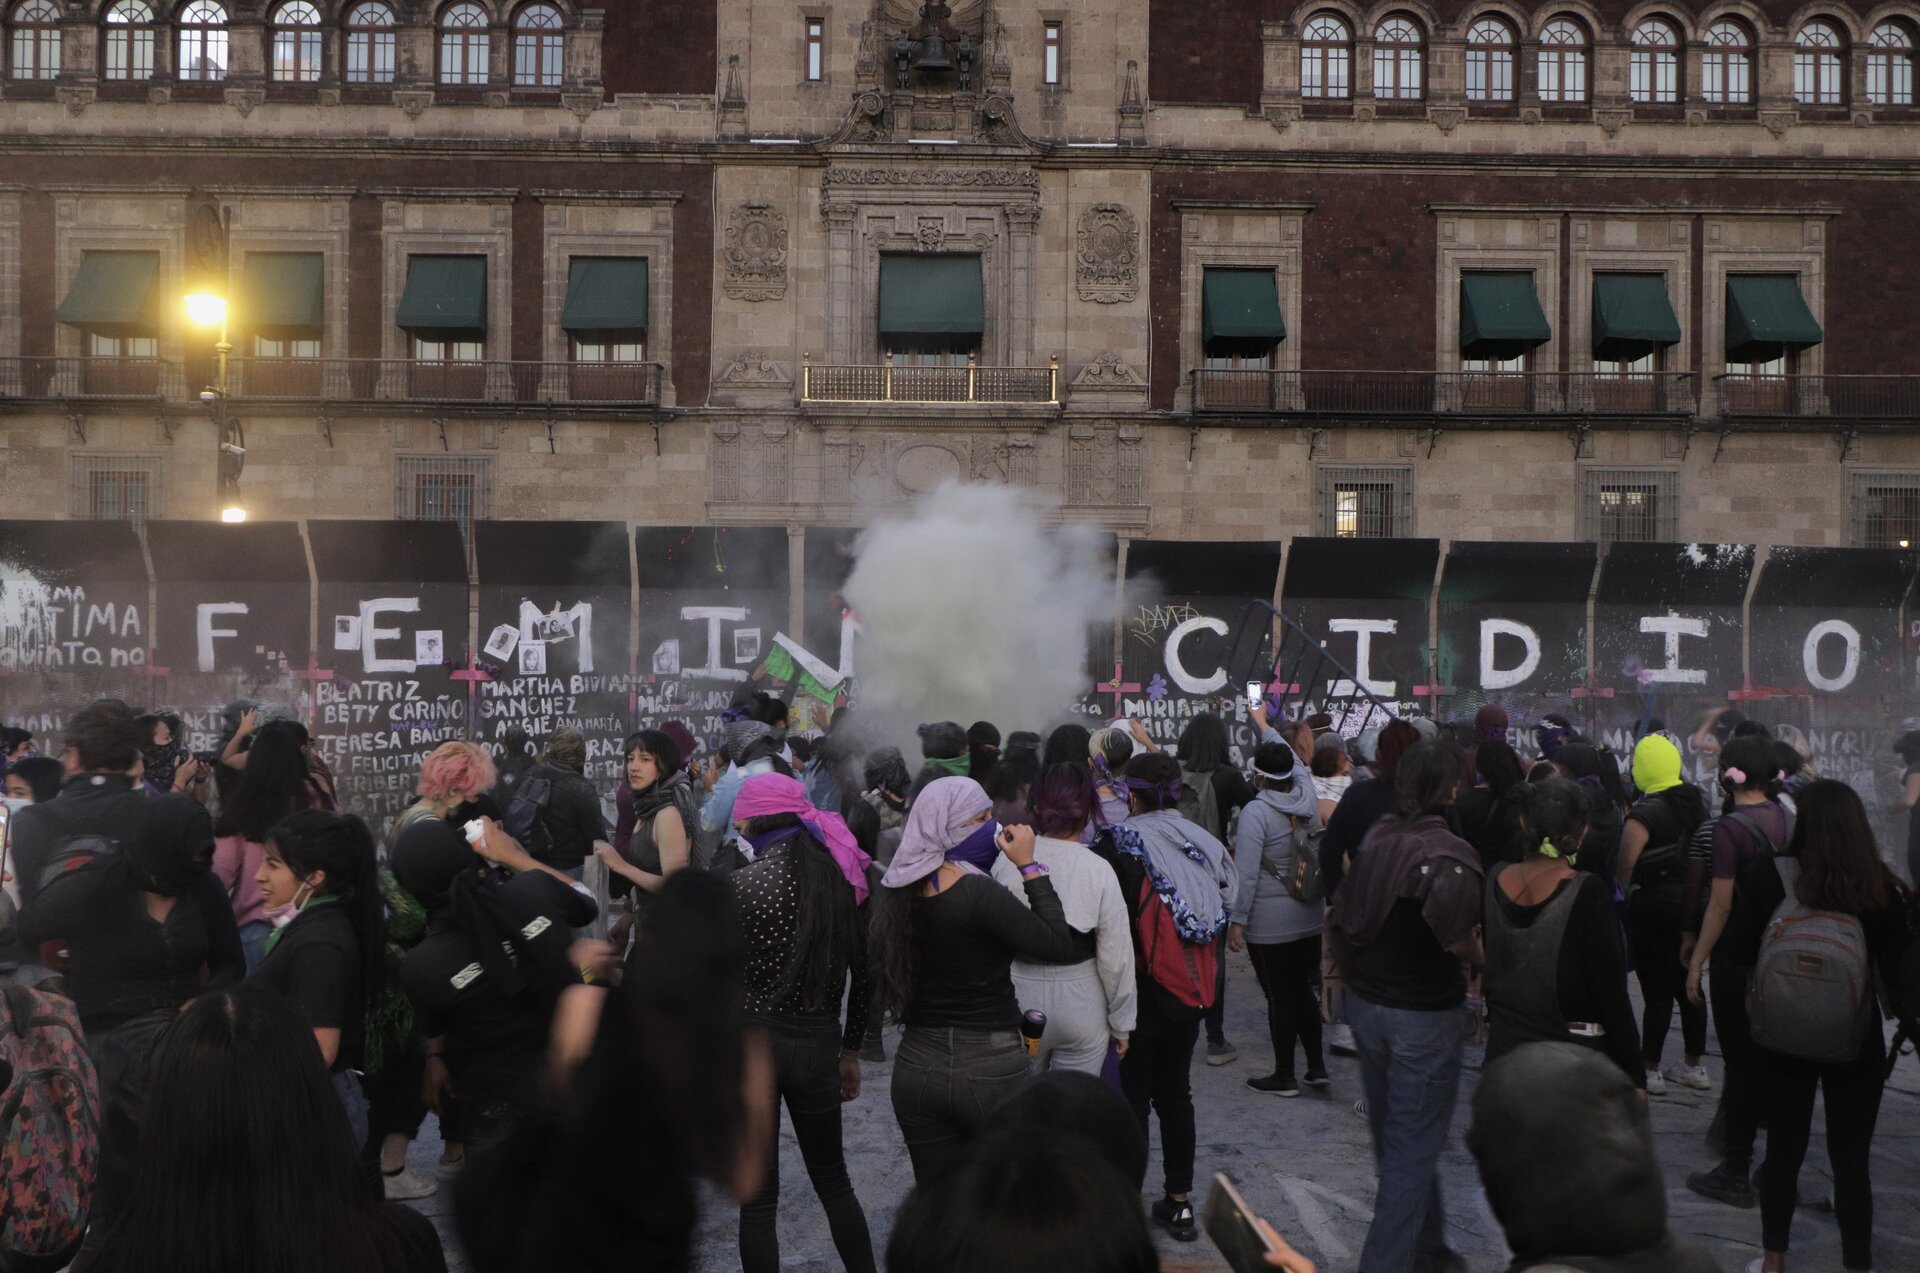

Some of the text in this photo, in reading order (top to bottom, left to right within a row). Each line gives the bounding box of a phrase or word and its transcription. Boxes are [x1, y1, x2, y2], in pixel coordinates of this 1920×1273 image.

[316, 681, 422, 706] BEATRIZ
[481, 676, 564, 697] MARTHA
[324, 704, 379, 724] BETY
[388, 695, 463, 720] CARIÑO
[480, 696, 577, 719] SANCHEZ
[1123, 697, 1210, 718] MIRIAM
[317, 731, 401, 754] TERESA
